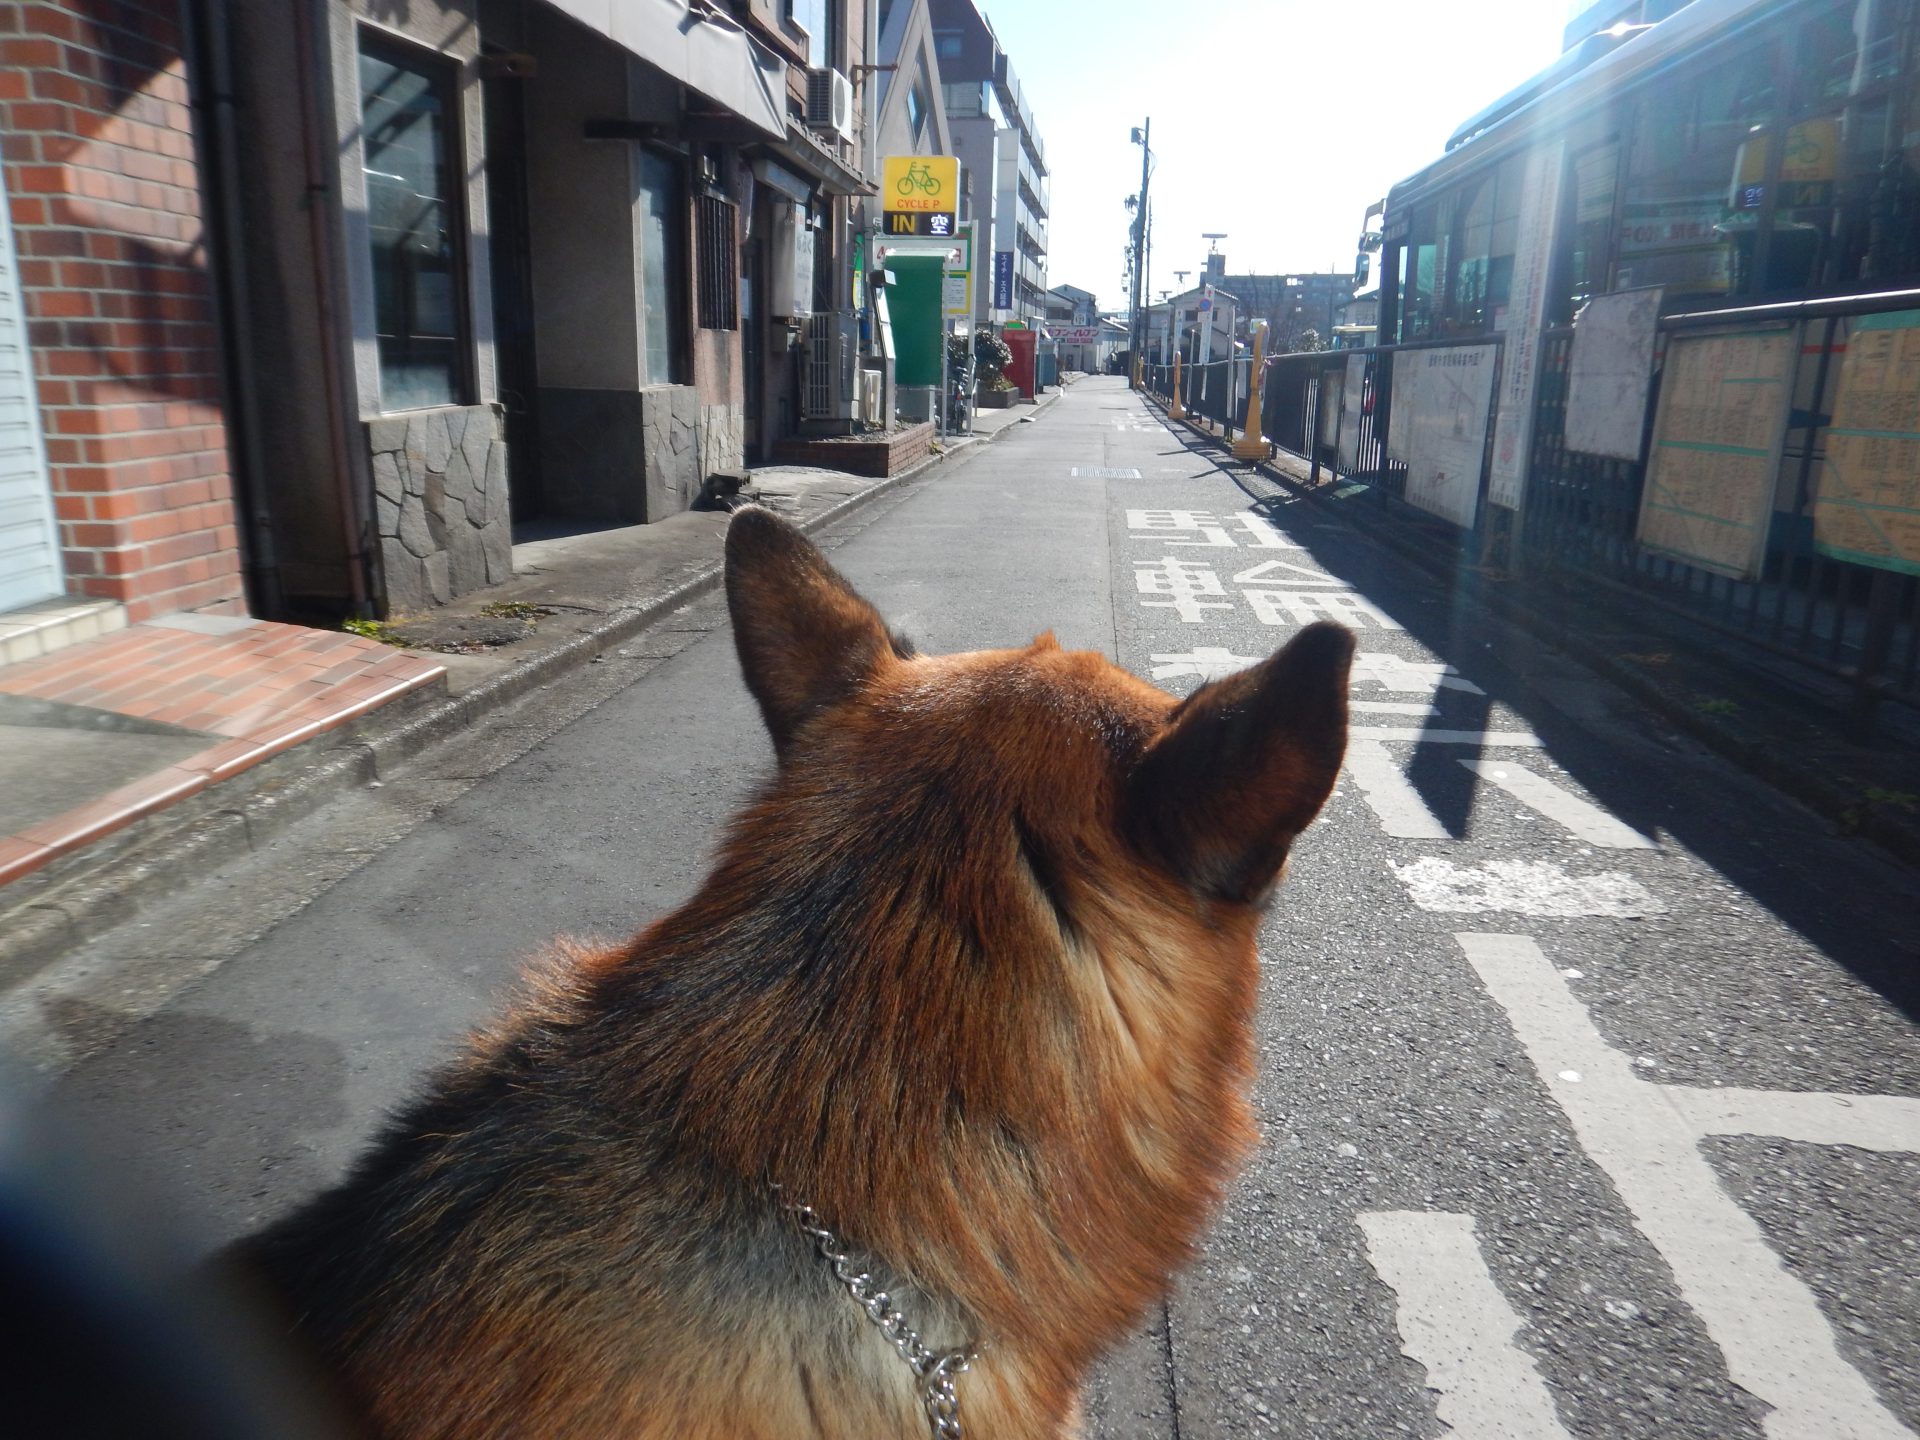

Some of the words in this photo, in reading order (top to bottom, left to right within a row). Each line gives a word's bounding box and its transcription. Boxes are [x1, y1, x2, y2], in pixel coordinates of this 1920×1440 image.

[897, 199, 928, 208] CYCLE
[933, 200, 940, 208] P
[893, 215, 915, 232] IN
[931, 214, 949, 234] 空
